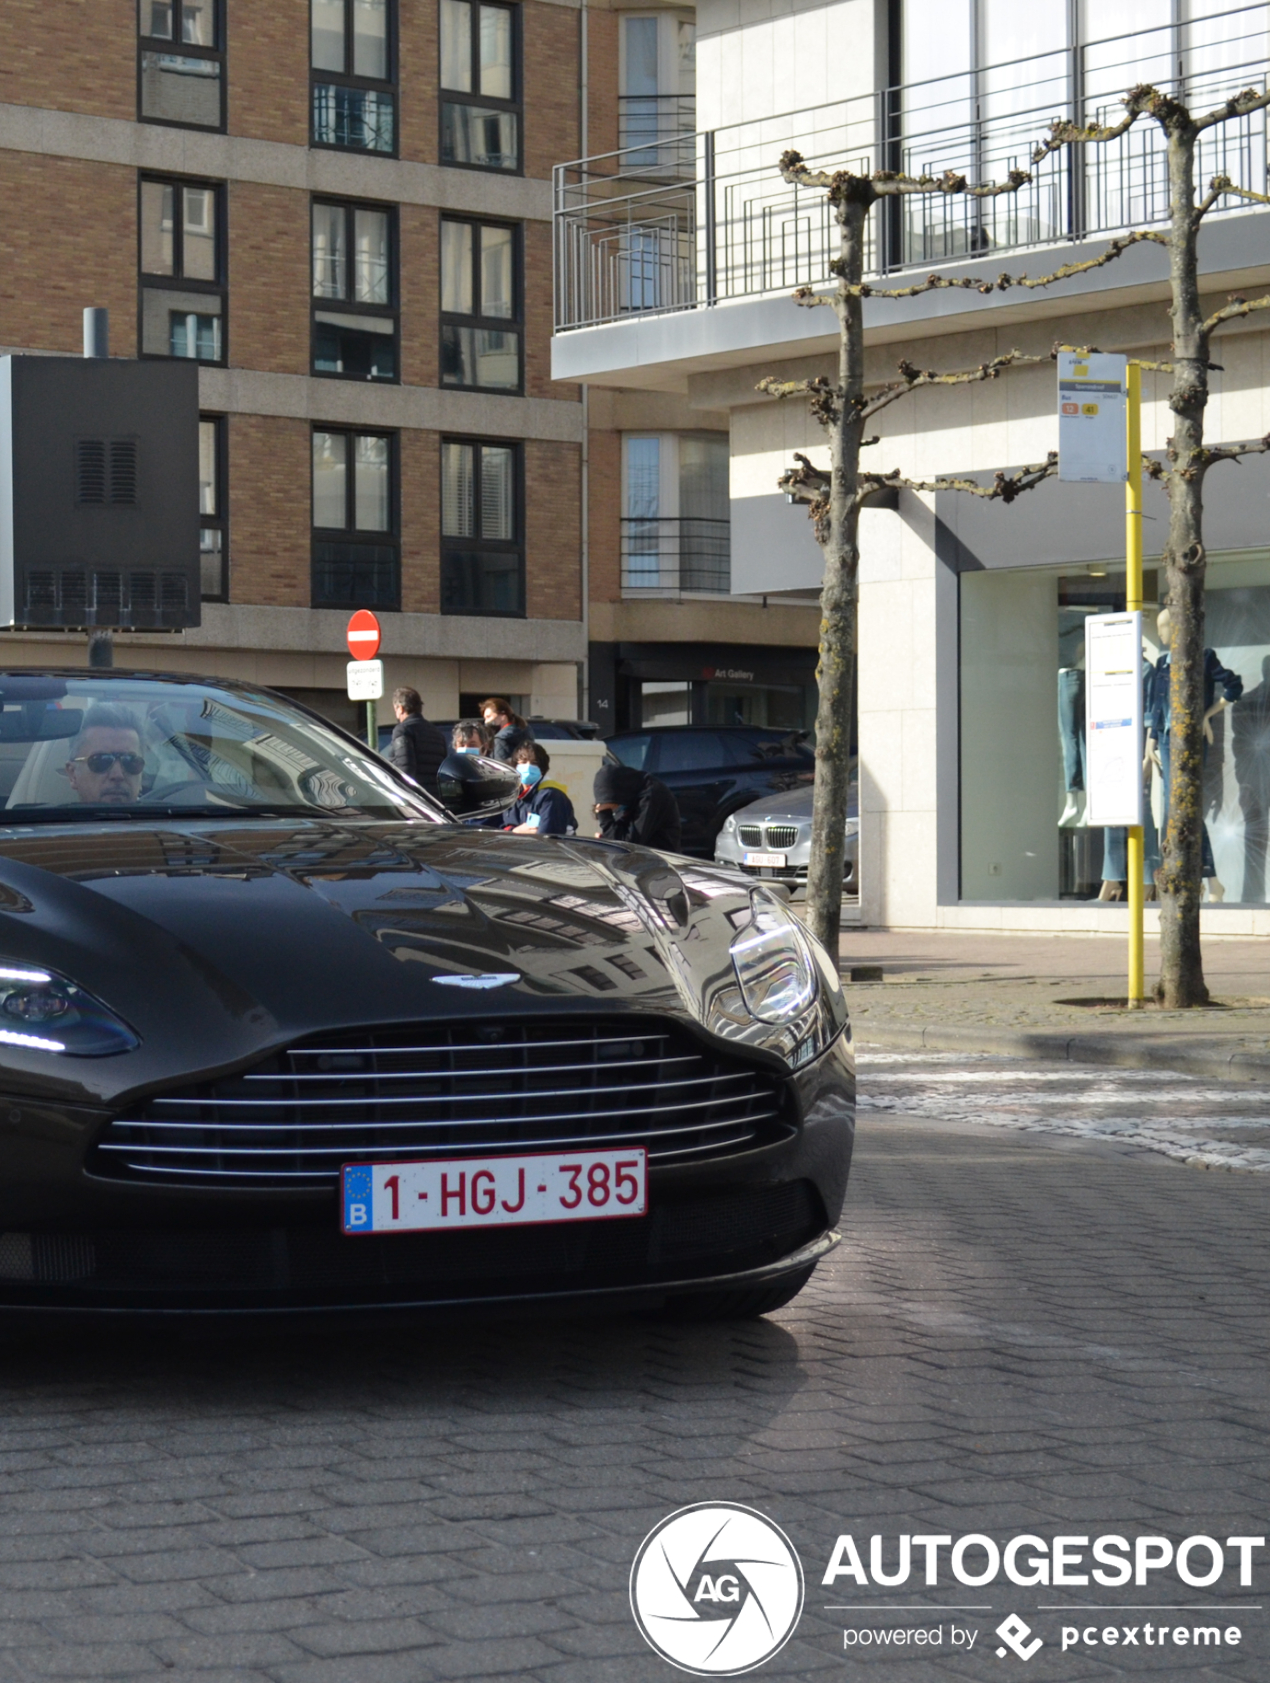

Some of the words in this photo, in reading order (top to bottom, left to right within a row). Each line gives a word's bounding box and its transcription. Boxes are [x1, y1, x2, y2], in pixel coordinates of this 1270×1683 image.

[1066, 405, 1074, 413] 12
[1086, 406, 1094, 414] 41
[715, 669, 727, 678] Art
[728, 669, 754, 681] Gallery
[597, 699, 609, 709] 14
[383, 1160, 638, 1220] 1-HGJ-385
[349, 1203, 368, 1225] B
